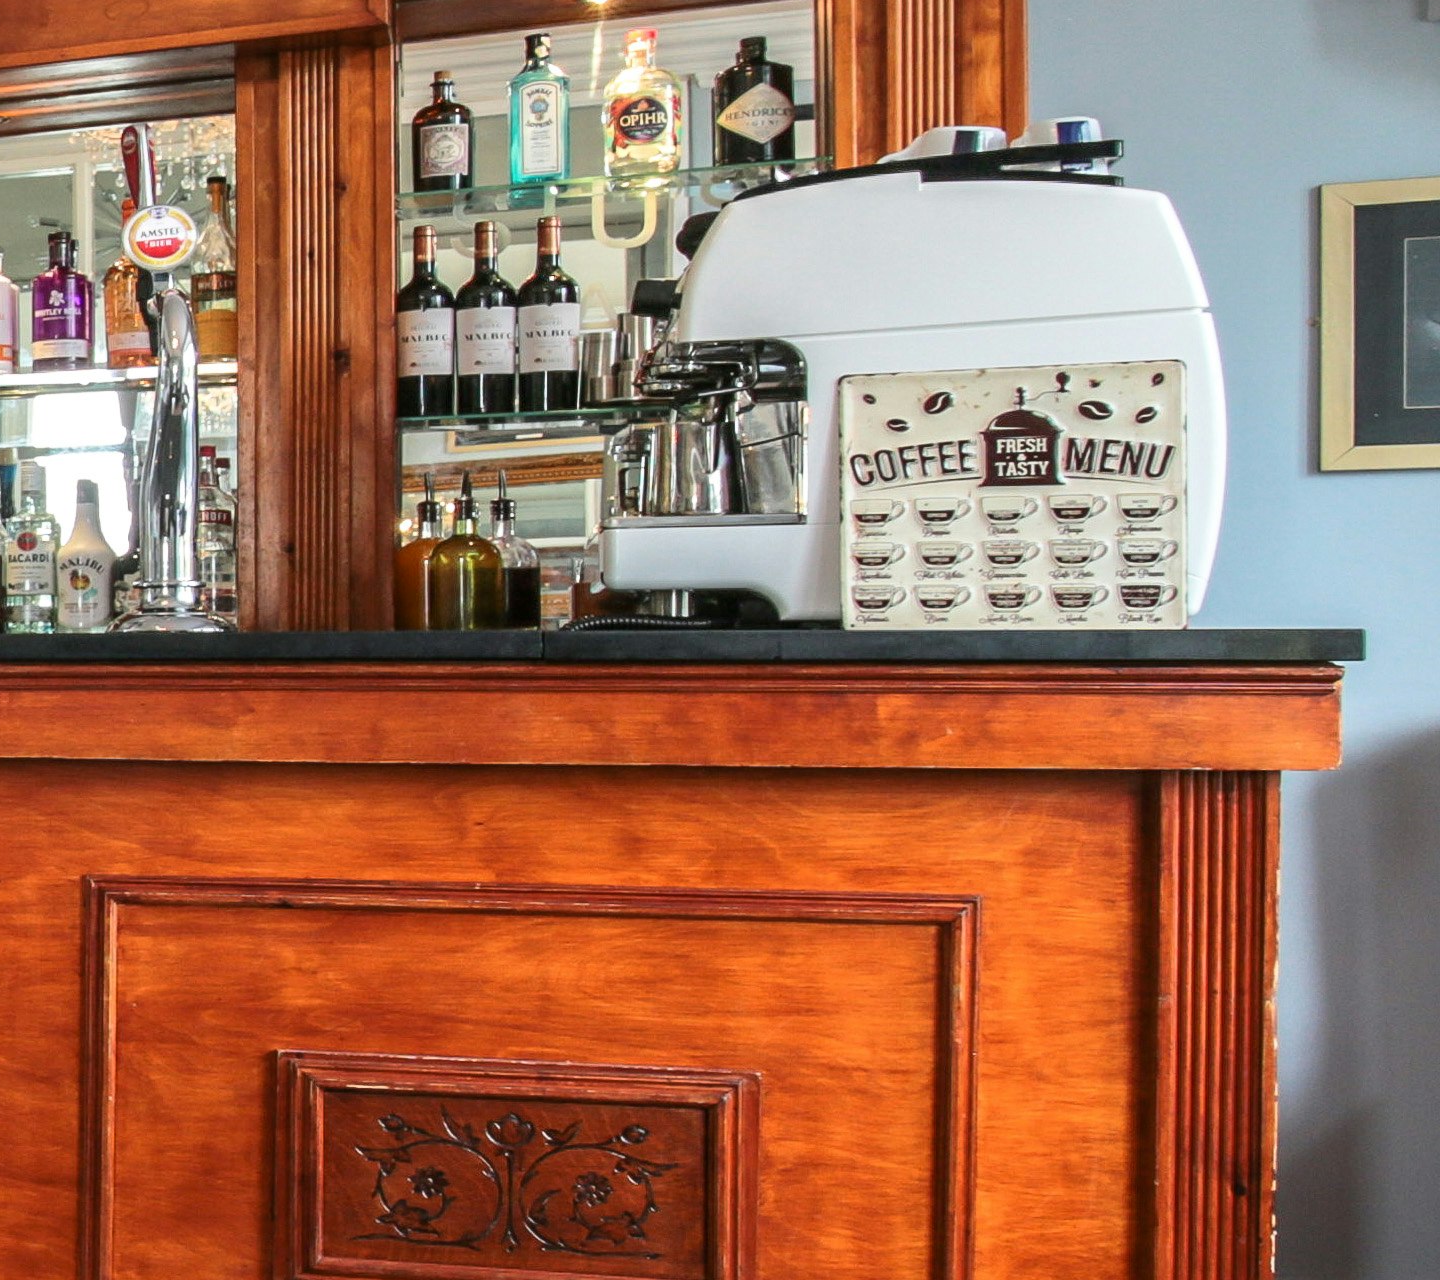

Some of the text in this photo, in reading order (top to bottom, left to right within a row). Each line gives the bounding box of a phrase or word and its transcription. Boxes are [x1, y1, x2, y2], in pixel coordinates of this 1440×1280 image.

[619, 110, 668, 128] OPIHR
[996, 437, 1047, 454] FRESH
[849, 438, 978, 487] COFFEE
[1065, 437, 1176, 480] MENU
[994, 461, 1050, 477] TASTY
[8, 553, 49, 563] BACARDI
[59, 557, 105, 575] MALIBU
